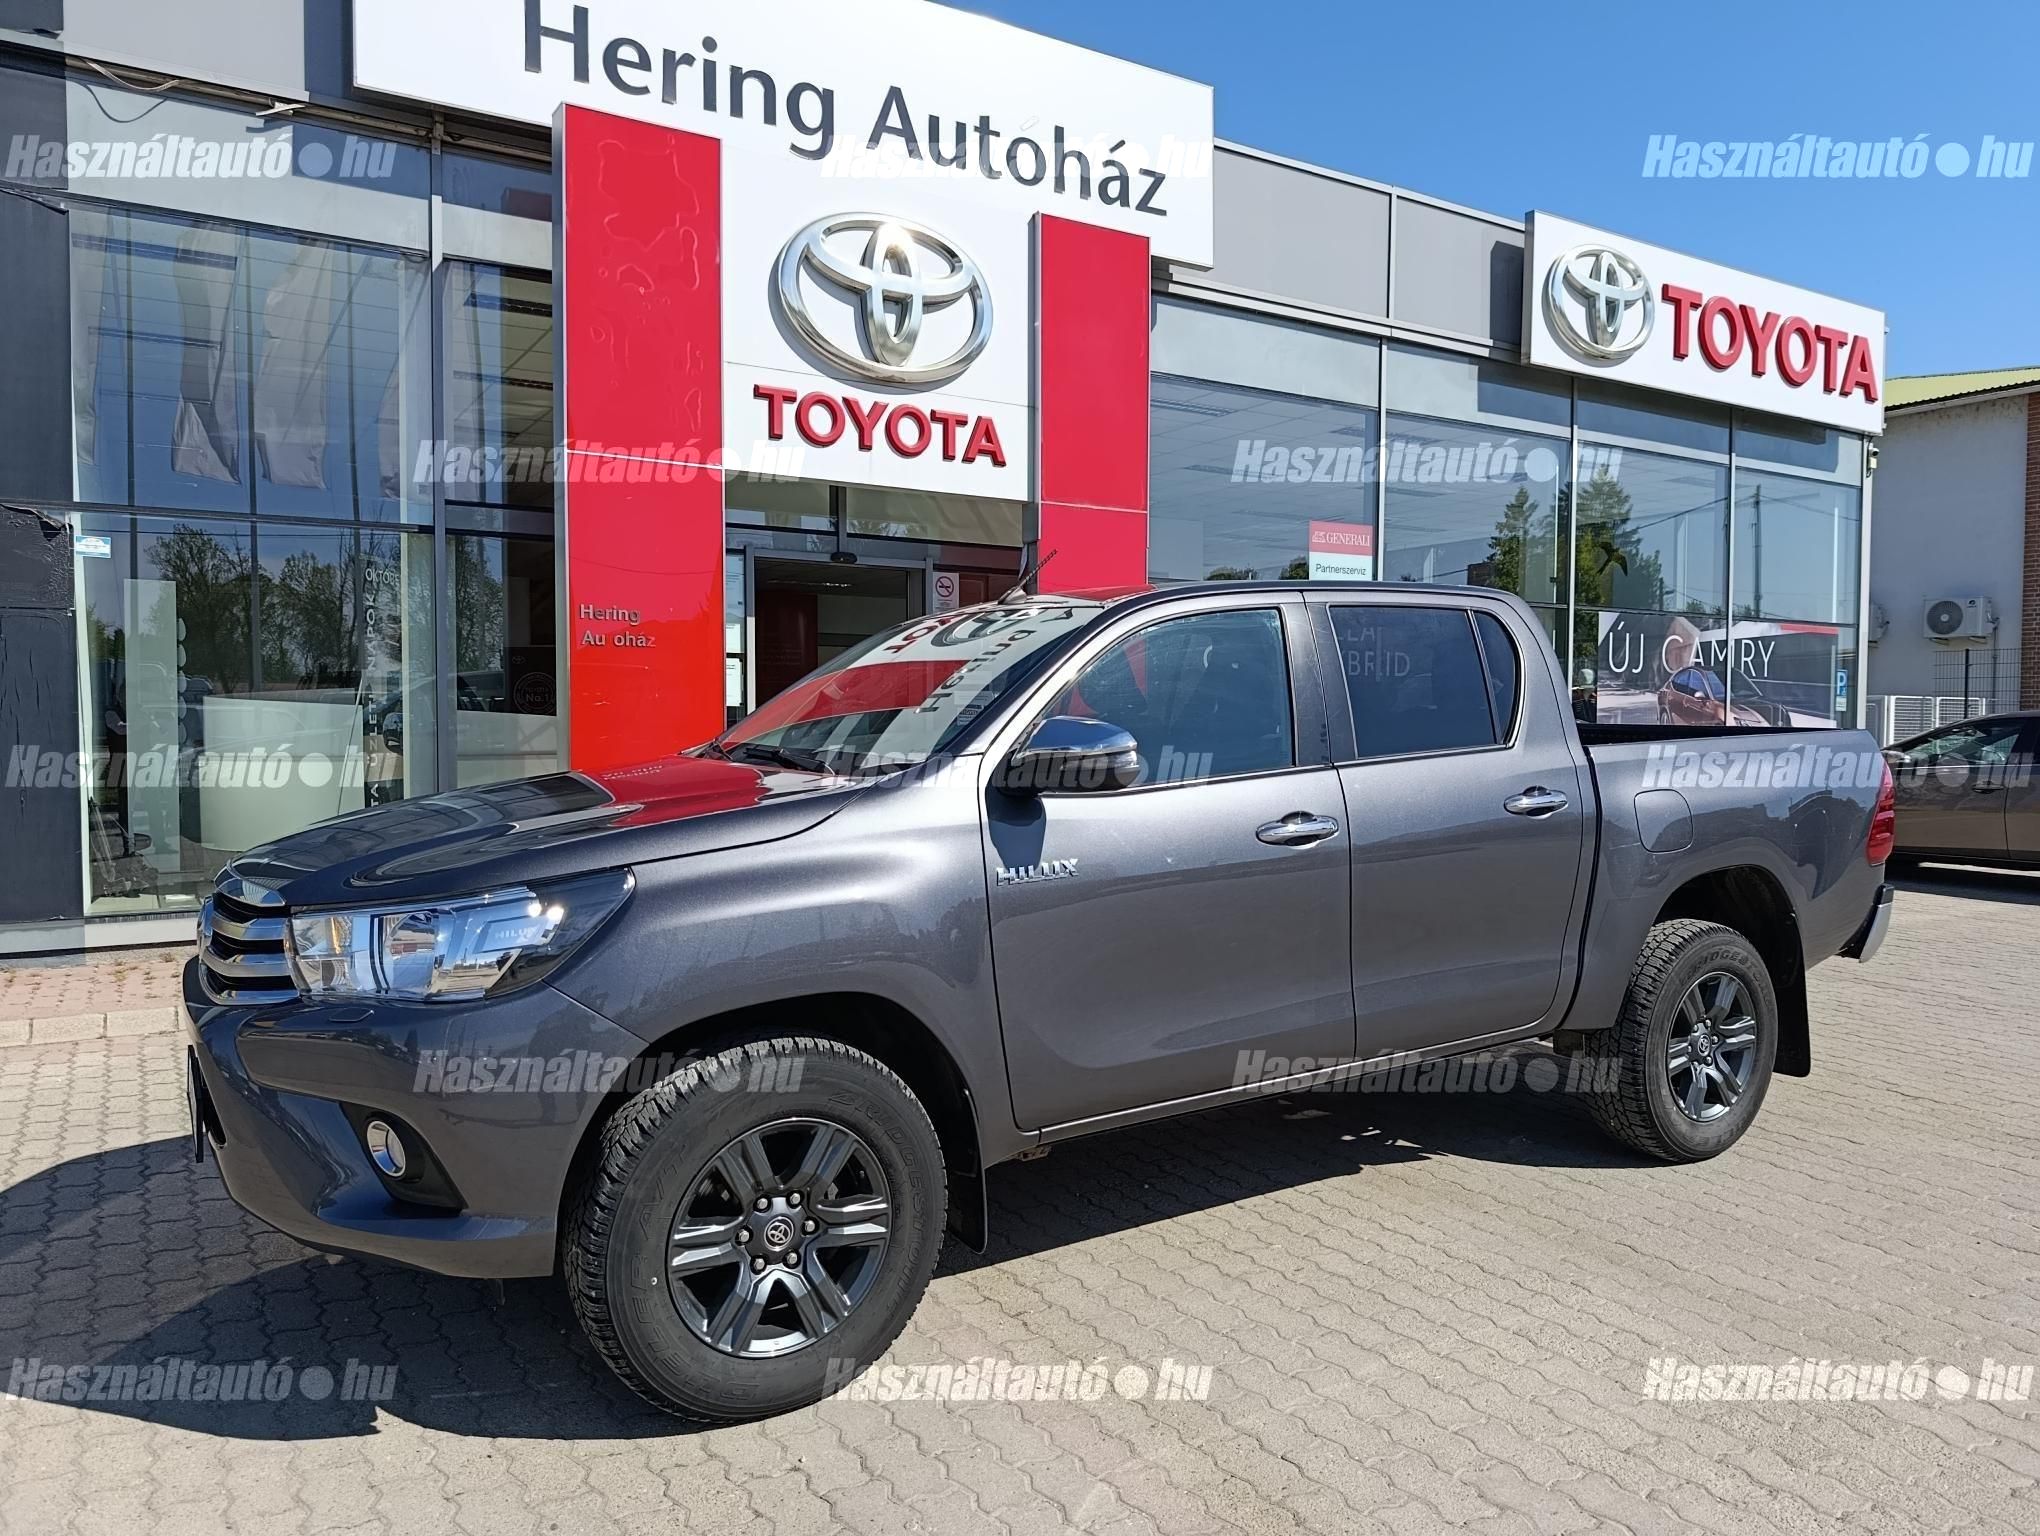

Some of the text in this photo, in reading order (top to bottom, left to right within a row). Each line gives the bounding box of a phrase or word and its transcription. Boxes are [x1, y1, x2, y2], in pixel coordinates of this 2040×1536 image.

[524, 0, 834, 161] Hering
[1661, 285, 1879, 404] TOYOTA
[753, 383, 1007, 467] TOYOTA
[1326, 531, 1370, 547] GENERALI
[1315, 563, 1367, 576] Partnerszerviz
[579, 603, 641, 626] Hering
[1608, 621, 1776, 678] ÚJ CAMRY
[996, 858, 1079, 887] HILUX
